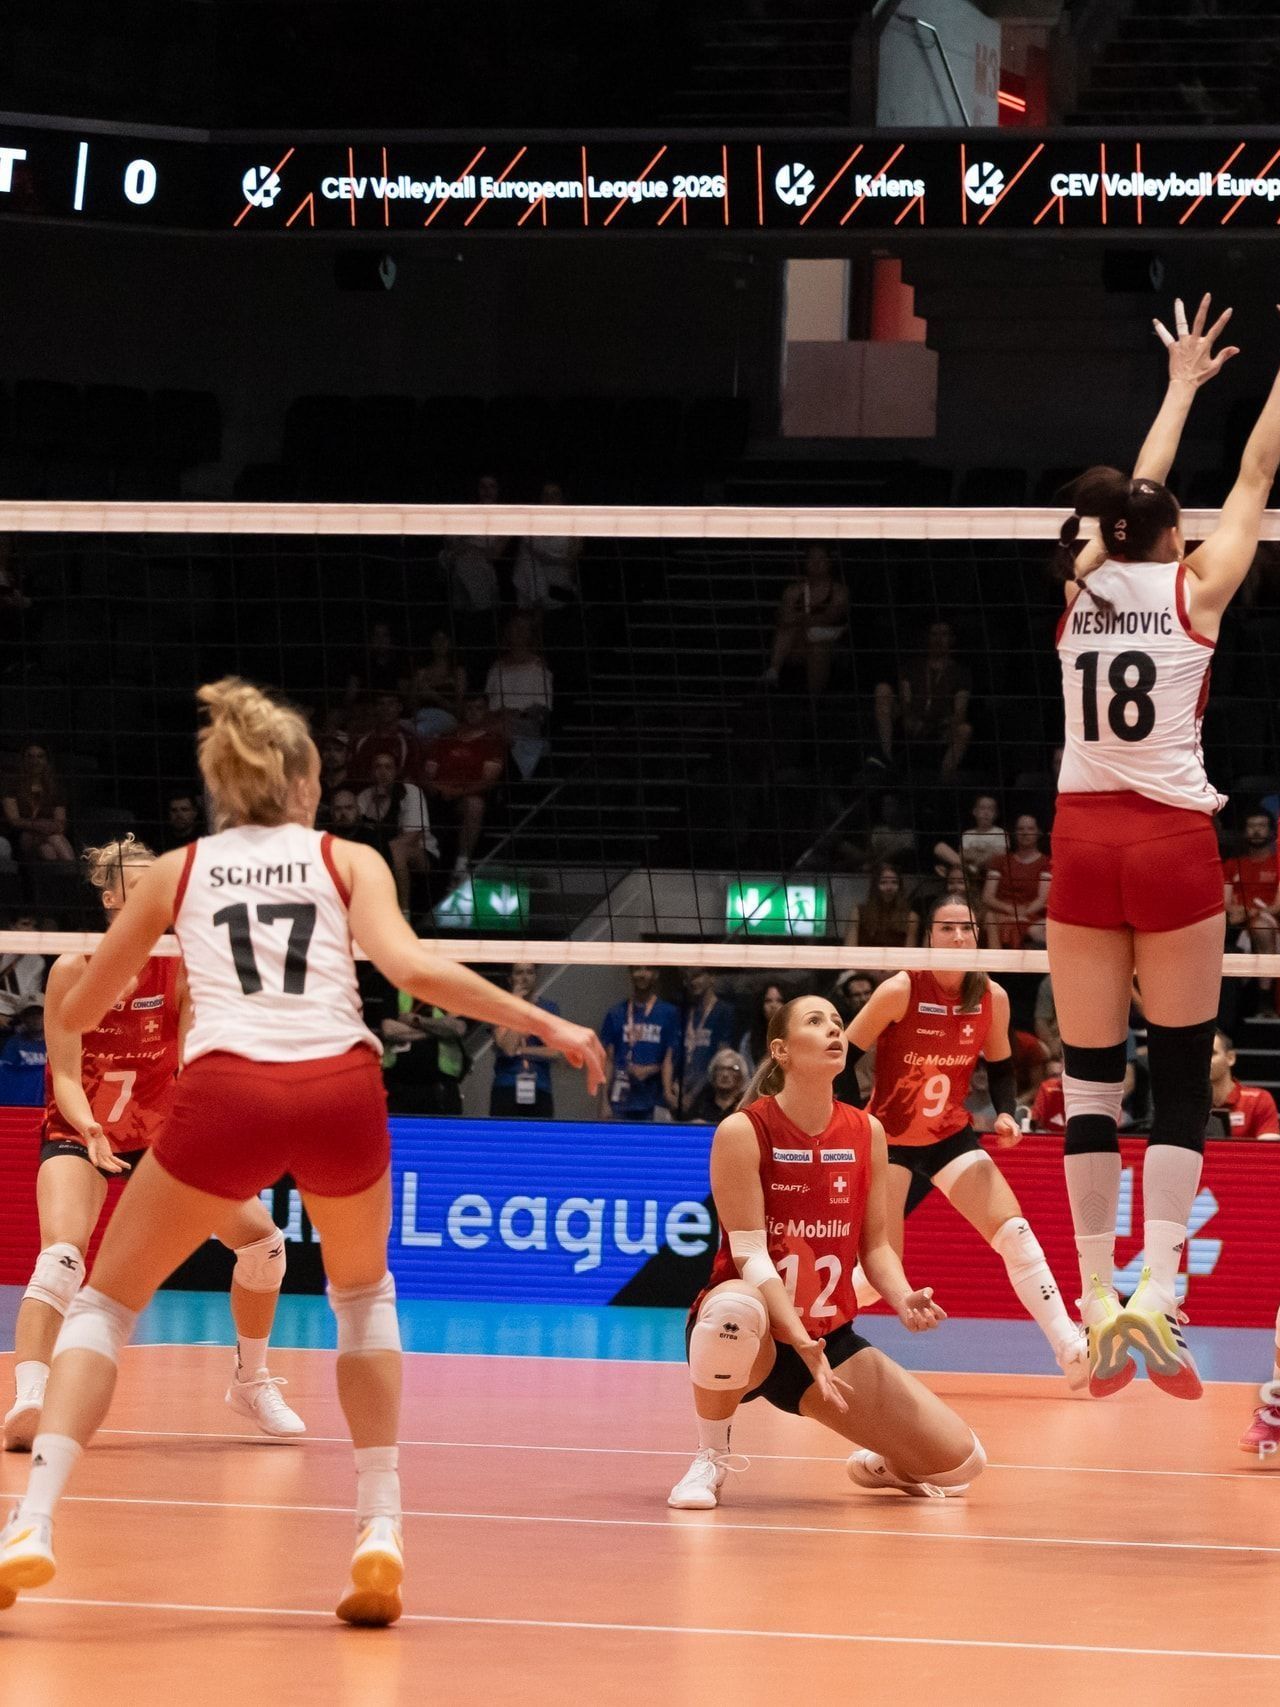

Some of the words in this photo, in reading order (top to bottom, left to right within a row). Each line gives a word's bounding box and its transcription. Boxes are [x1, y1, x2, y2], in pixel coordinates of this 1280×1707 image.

[124, 159, 157, 205] 0
[321, 177, 367, 199] CEV
[369, 175, 476, 203] Volleyball
[480, 176, 583, 203] European
[588, 176, 668, 203] League
[672, 176, 727, 198] 2026
[855, 172, 926, 197] Kriens
[1050, 173, 1099, 197] CEV
[1101, 173, 1213, 201] Volleyball
[1072, 607, 1172, 635] NESIMOVIĆ
[1075, 650, 1157, 742] 18
[210, 862, 312, 887] SCHMIT
[213, 902, 317, 995] 17
[104, 1070, 137, 1123] 7
[922, 1073, 951, 1118] 9
[771, 1183, 803, 1192] CRAFT
[776, 1254, 842, 1318] 12
